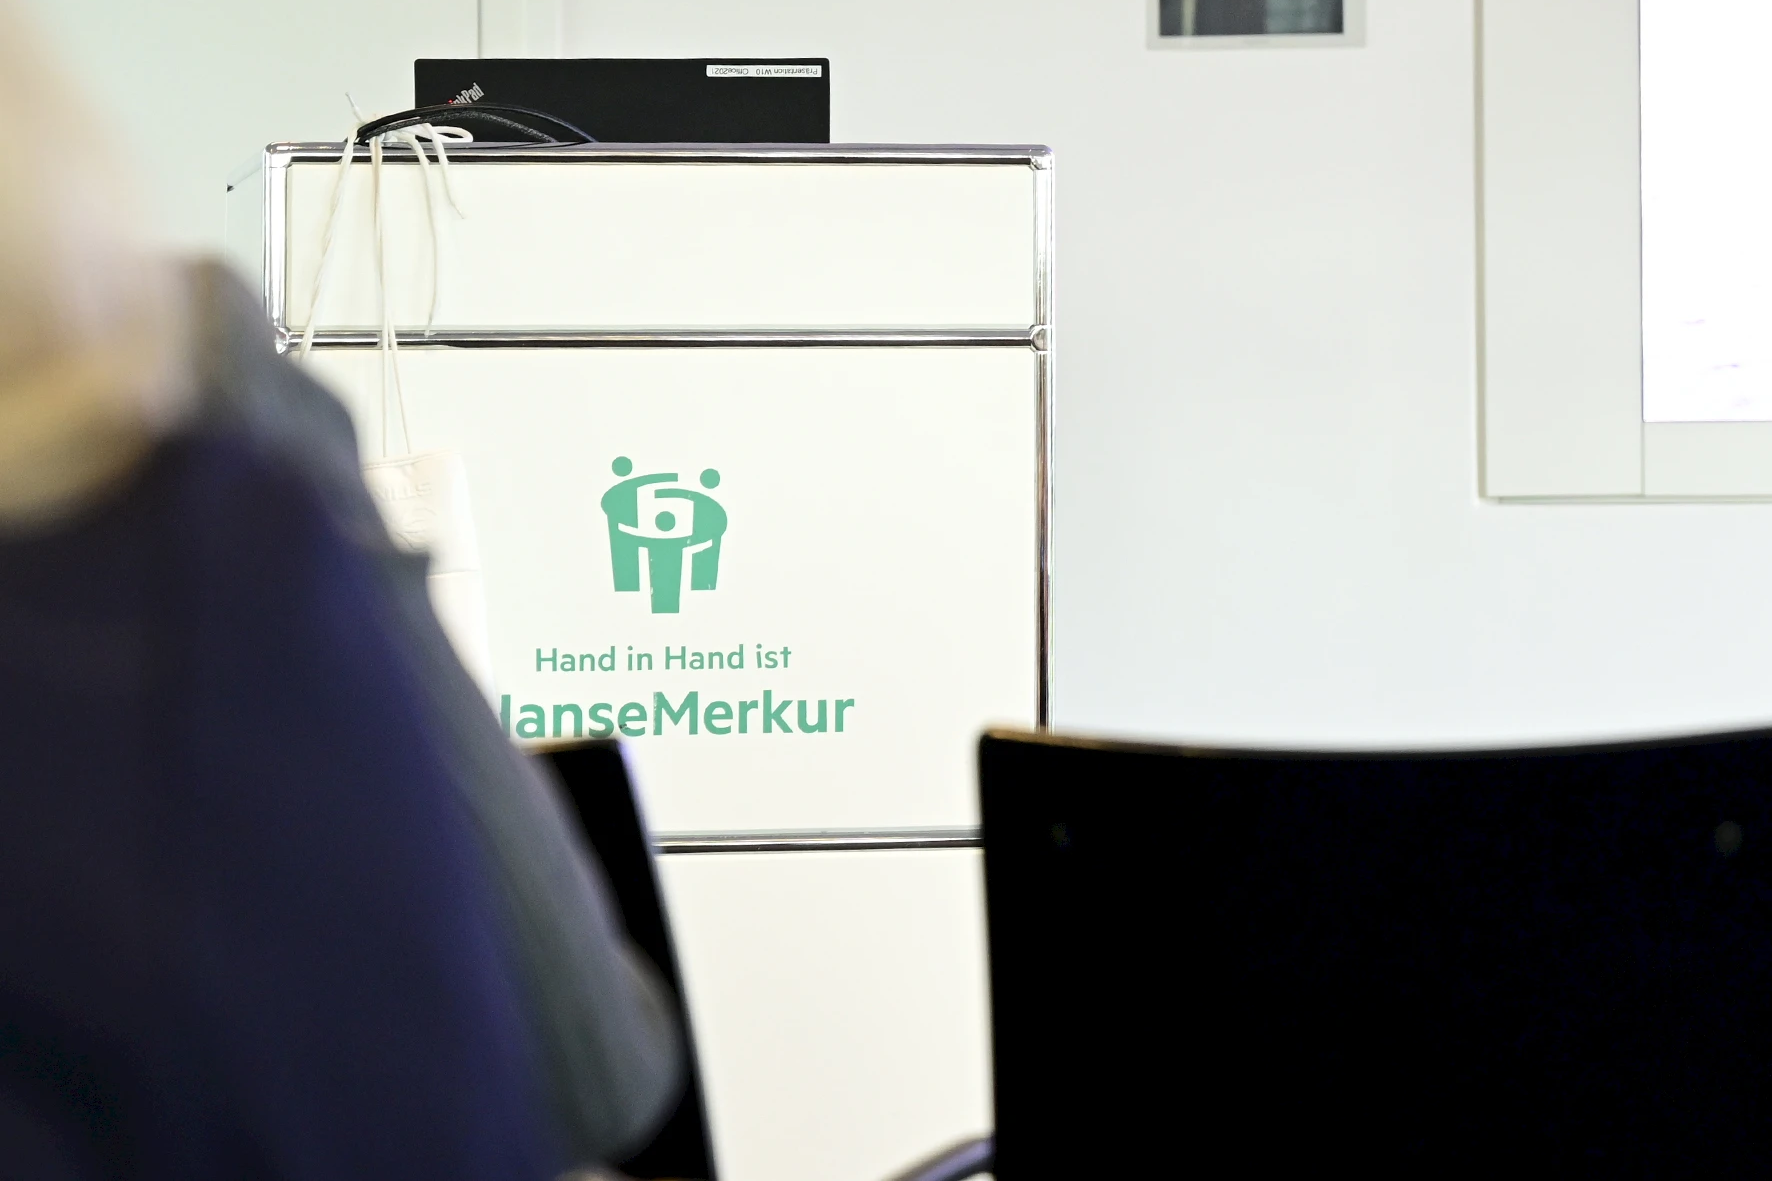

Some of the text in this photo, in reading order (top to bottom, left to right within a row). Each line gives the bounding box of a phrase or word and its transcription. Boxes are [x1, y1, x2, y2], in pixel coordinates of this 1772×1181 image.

[773, 67, 818, 76] Präsentation
[535, 643, 792, 673] Hand in Hand ist
[500, 689, 855, 739] anseMerkur
